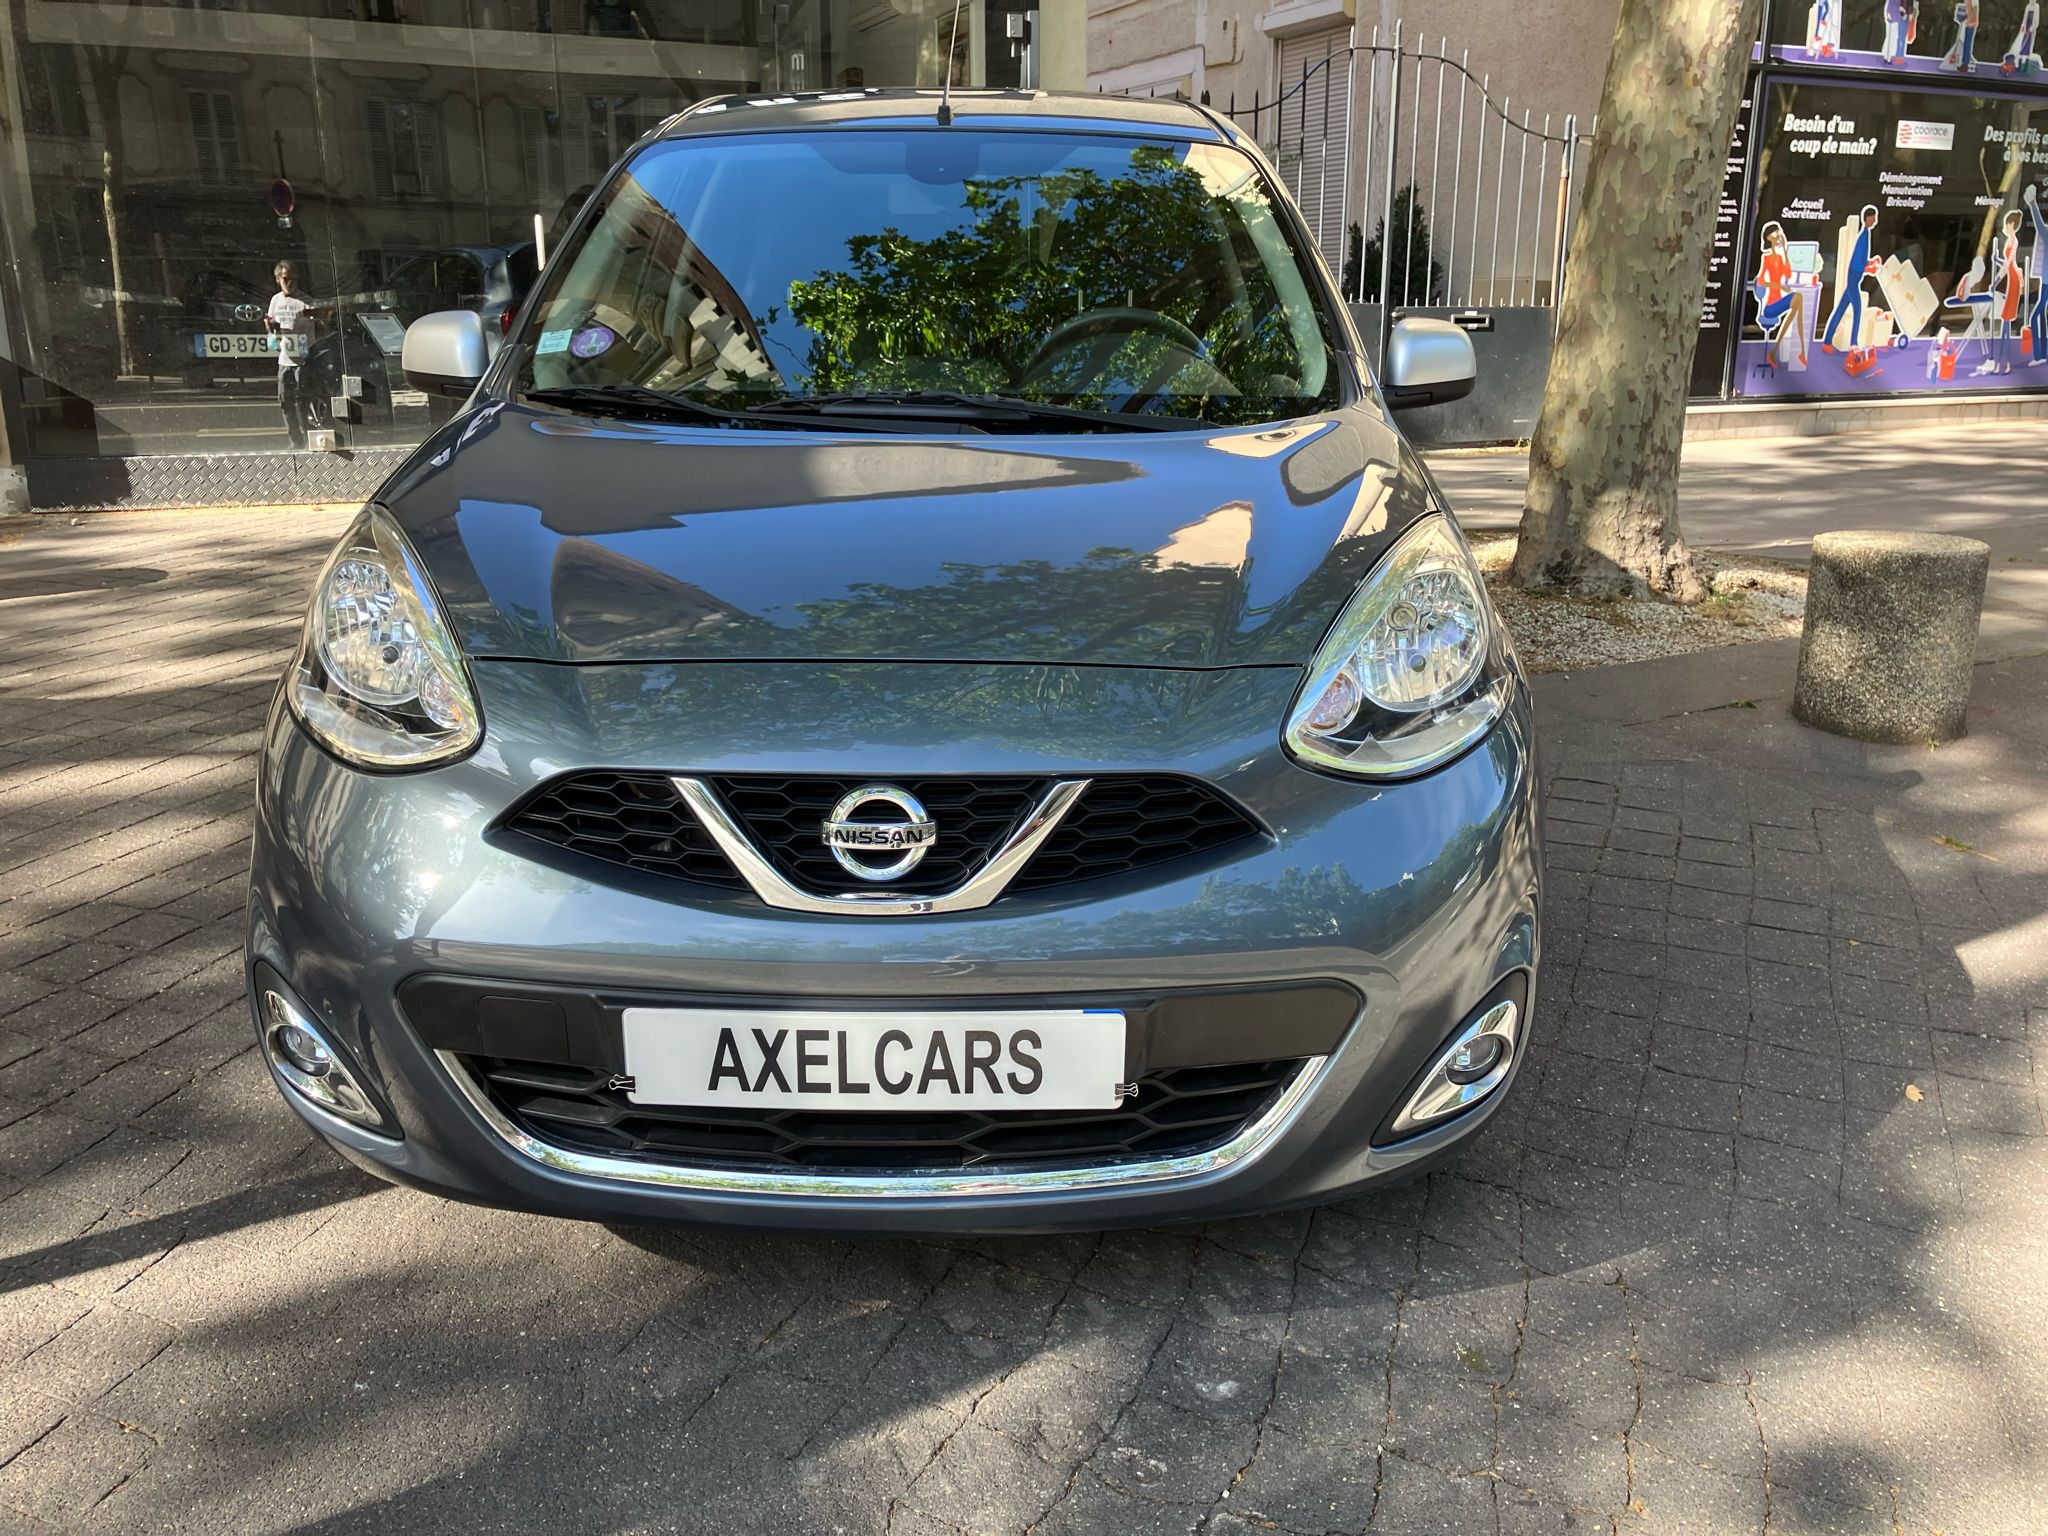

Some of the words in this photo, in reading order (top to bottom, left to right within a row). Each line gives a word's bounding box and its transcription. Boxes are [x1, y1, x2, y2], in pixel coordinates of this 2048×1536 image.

[1783, 113, 1826, 133] Besoin
[1827, 114, 1855, 134] d'un
[1914, 127, 1948, 136] coorace
[1984, 125, 2005, 142] Des
[2005, 127, 2041, 148] profils
[1789, 139, 1821, 159] coup
[1822, 135, 1838, 154] de
[1839, 137, 1878, 155] main?
[1879, 171, 1942, 186] Déménagement
[1881, 184, 1933, 197] Manutention
[1791, 197, 1825, 210] Accueil
[1886, 196, 1925, 211] Bricolage
[1781, 206, 1832, 220] Secrétariat
[834, 829, 923, 845] NISSAN
[707, 1027, 1043, 1095] AXELCARS
